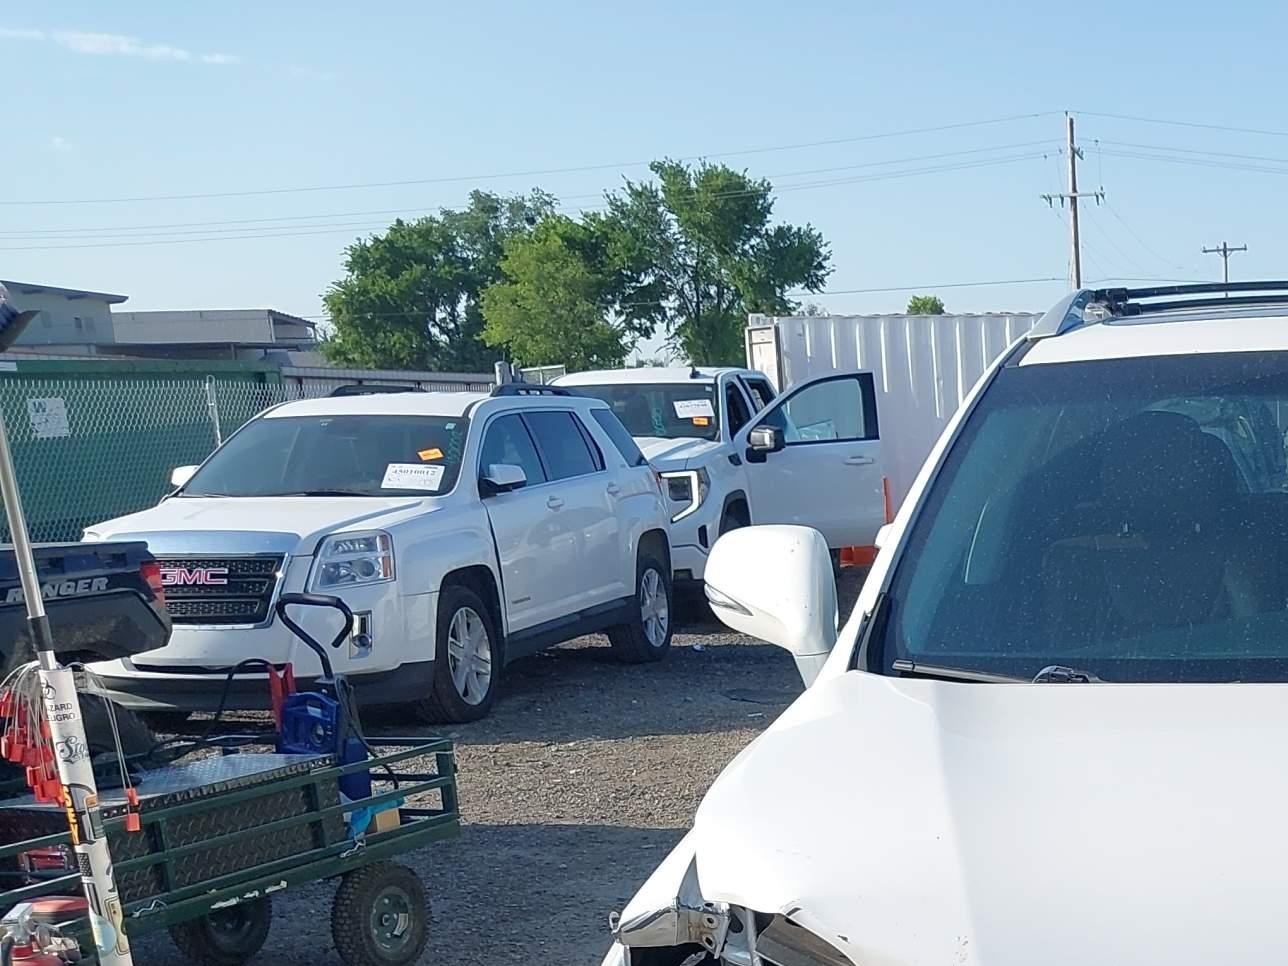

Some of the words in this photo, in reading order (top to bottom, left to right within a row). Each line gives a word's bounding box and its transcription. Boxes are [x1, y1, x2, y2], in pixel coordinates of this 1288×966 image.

[160, 568, 229, 585] GMC
[6, 576, 109, 603] RNGER
[48, 702, 73, 712] ZARD
